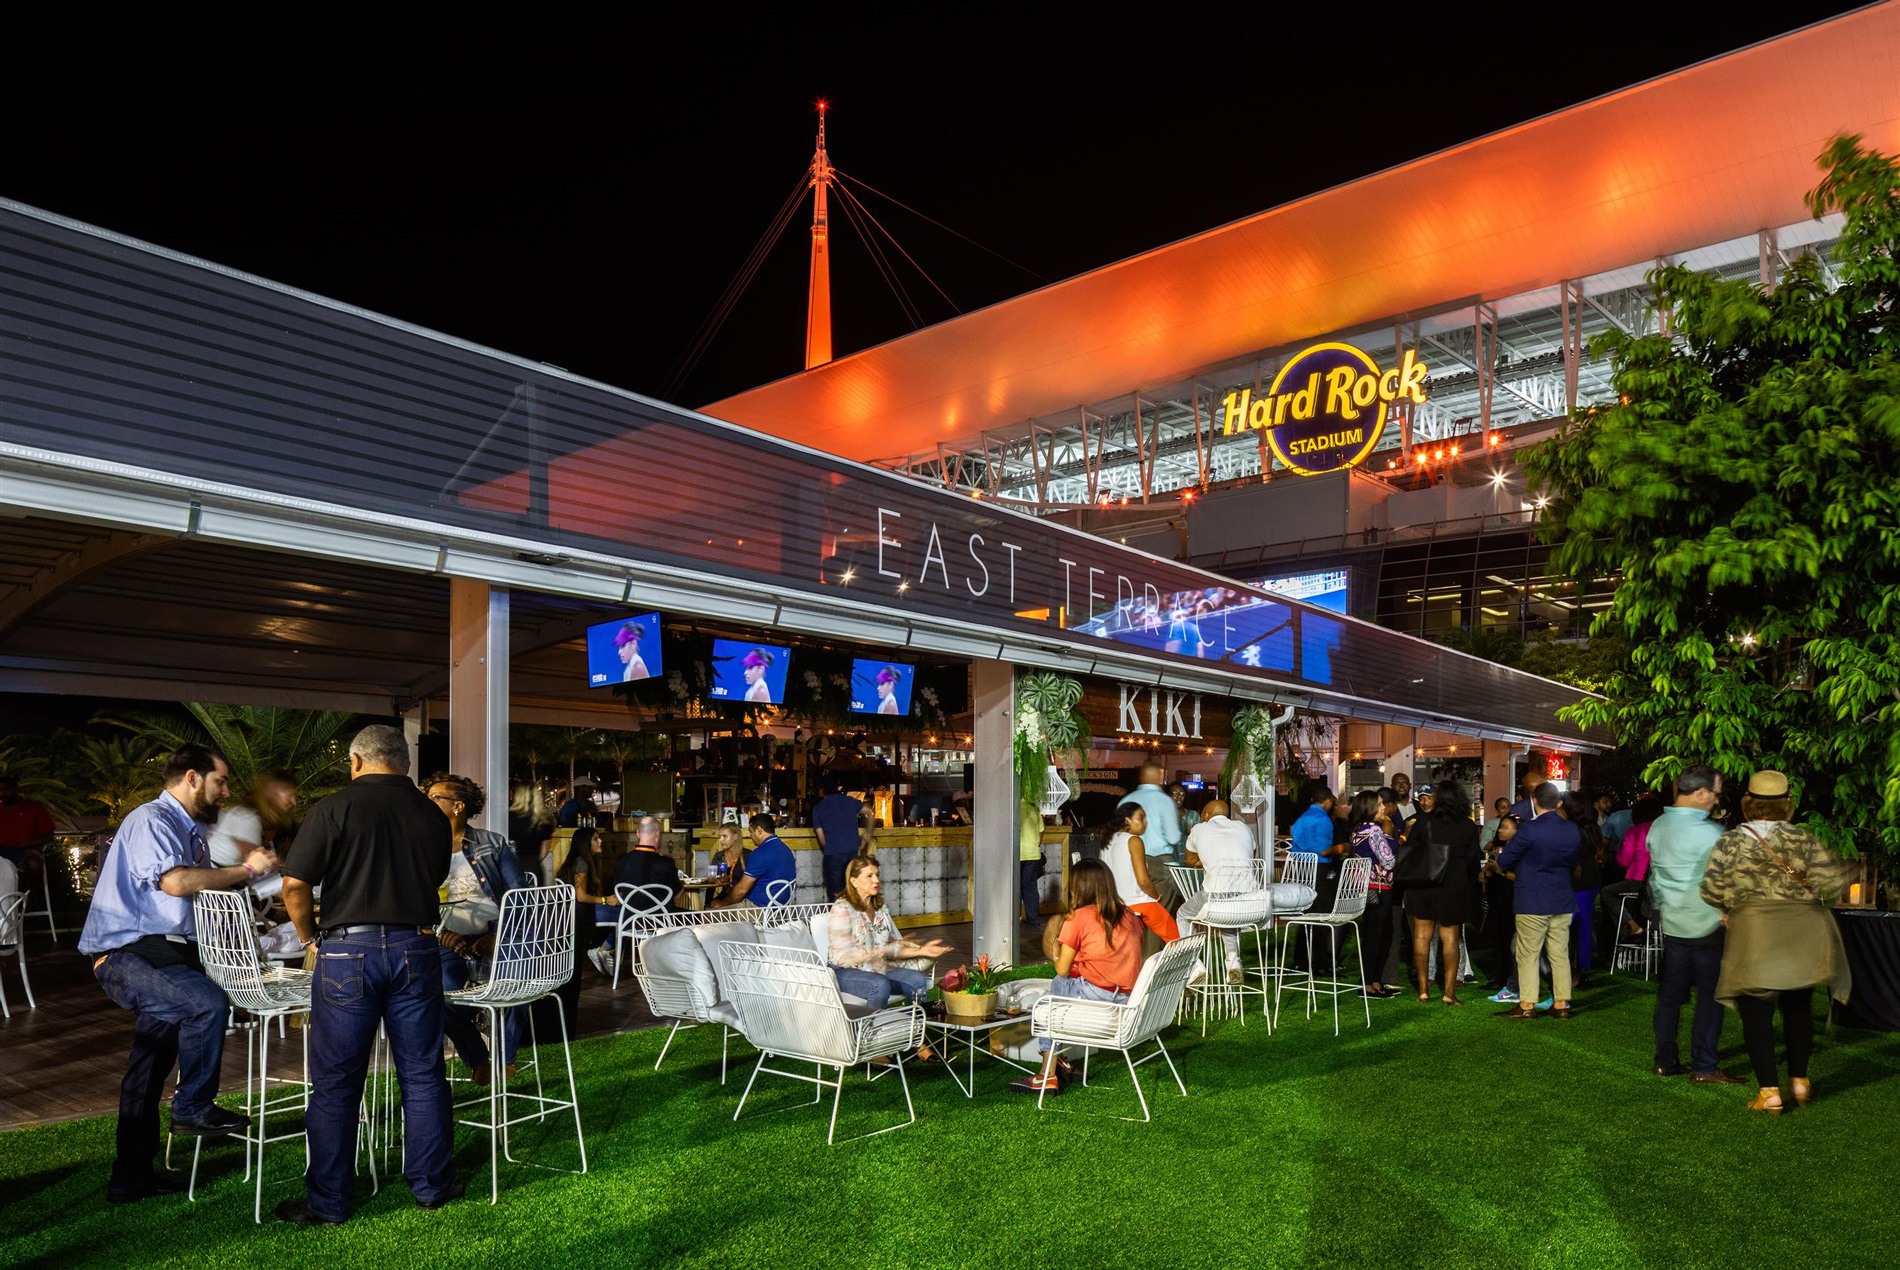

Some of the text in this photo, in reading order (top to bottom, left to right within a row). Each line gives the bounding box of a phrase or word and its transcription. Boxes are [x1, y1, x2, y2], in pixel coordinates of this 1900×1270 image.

[1223, 350, 1428, 435] Hard Rock
[1289, 428, 1363, 456] STADIUM
[878, 507, 1236, 652] EAST TERRACE
[1116, 682, 1204, 739] KIKI
